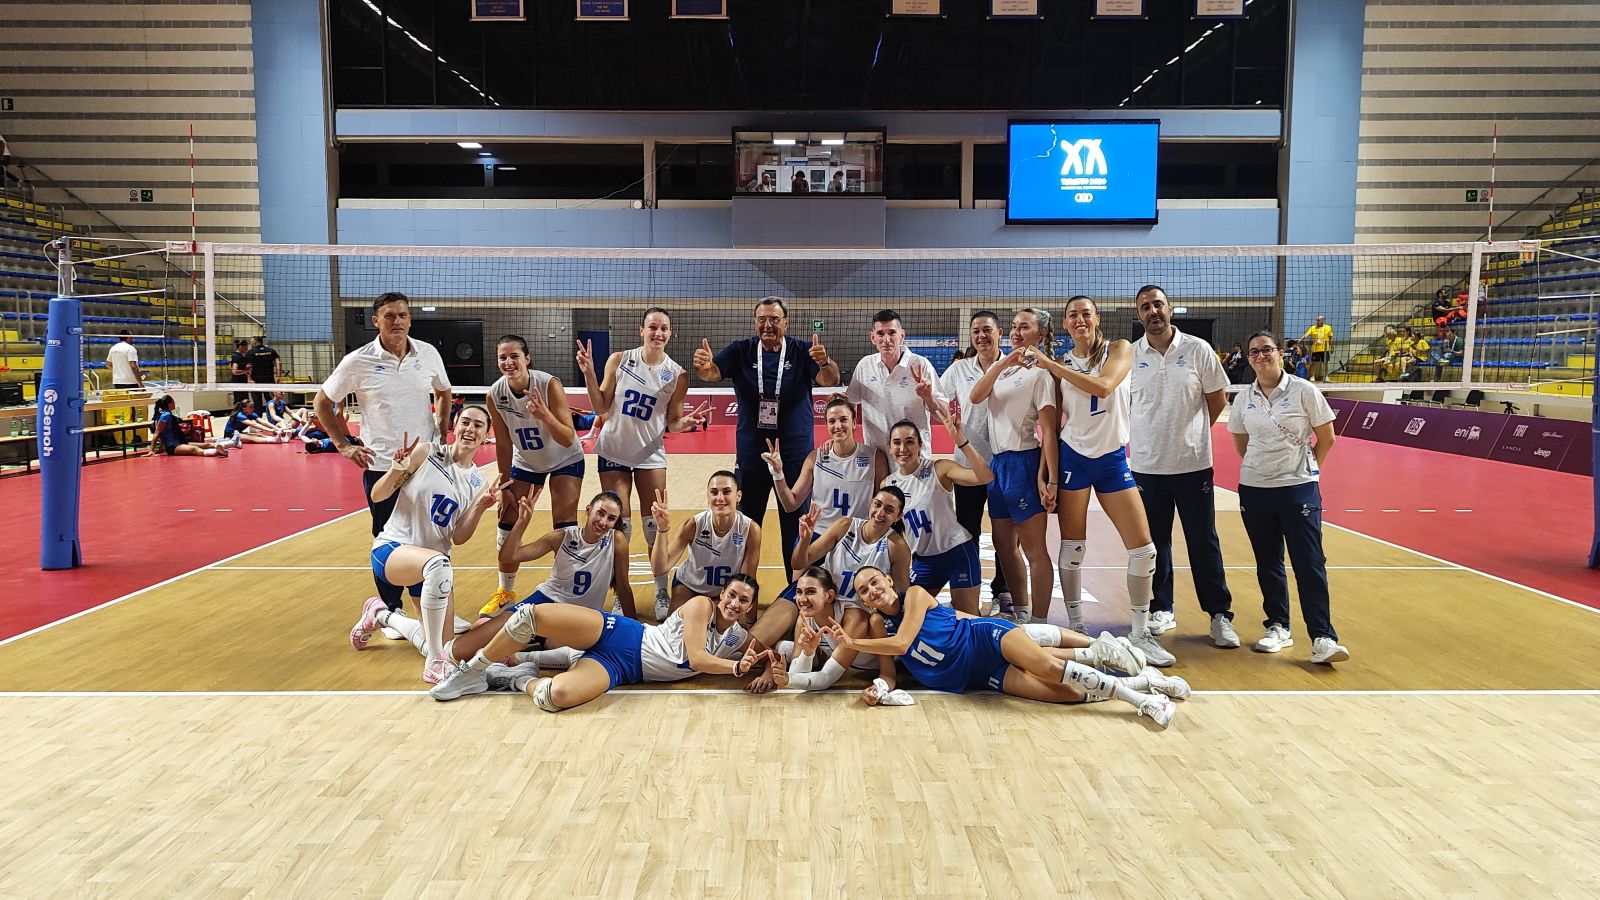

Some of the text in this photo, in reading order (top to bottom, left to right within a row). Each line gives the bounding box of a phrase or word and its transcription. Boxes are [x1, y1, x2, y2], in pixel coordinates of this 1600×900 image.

[622, 389, 657, 422] 25
[43, 404, 55, 457] Senoh
[515, 428, 544, 451] 15
[1454, 426, 1471, 438] eni
[1533, 447, 1552, 459] Jeep
[1064, 471, 1072, 484] 7
[431, 494, 459, 528] 19
[833, 489, 850, 516] 4
[904, 508, 932, 539] 14
[573, 571, 592, 596] 9
[704, 566, 731, 587] 16
